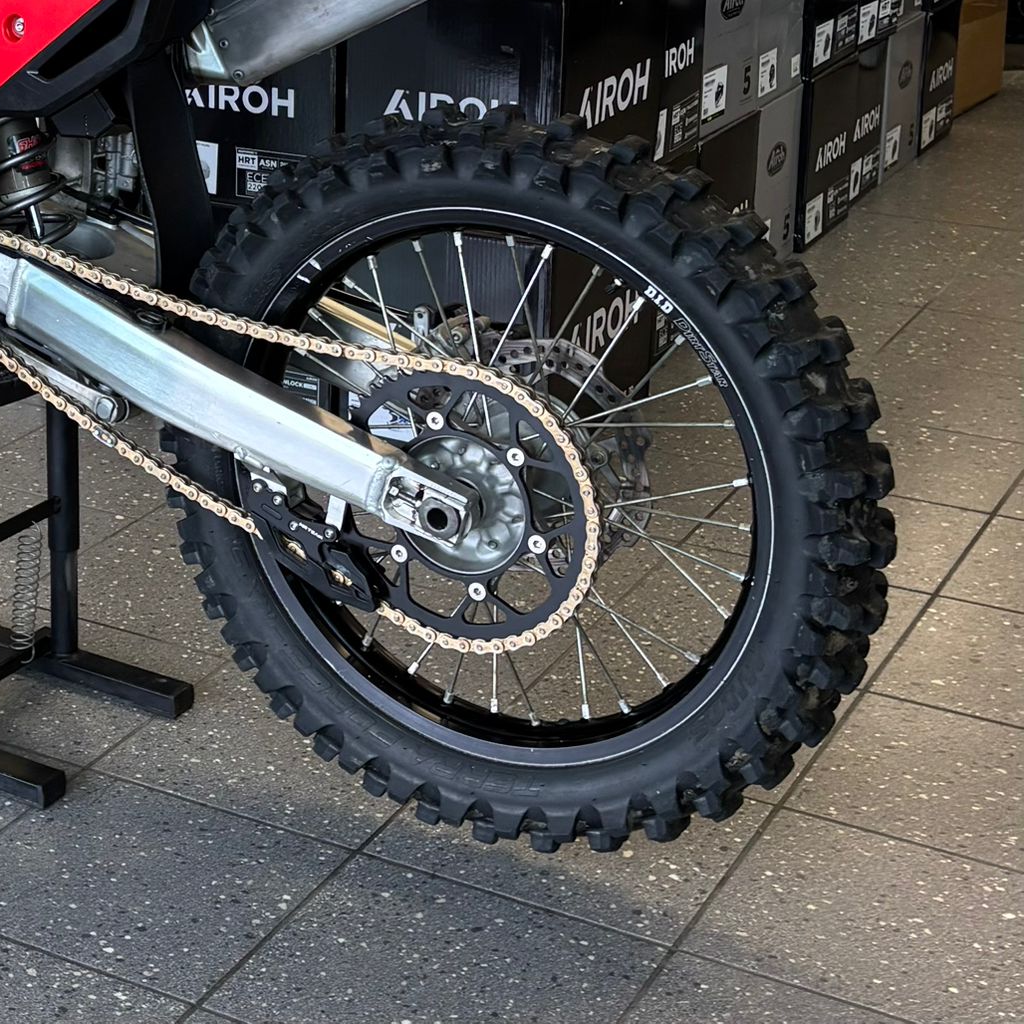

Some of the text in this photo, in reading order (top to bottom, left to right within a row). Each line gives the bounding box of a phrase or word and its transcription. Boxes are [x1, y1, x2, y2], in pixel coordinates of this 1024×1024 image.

[743, 67, 751, 96] 5
[929, 57, 953, 92] AIROH
[184, 84, 295, 119] AIROH
[382, 88, 518, 123] AIRO
[579, 58, 651, 130] AIROH
[853, 104, 881, 143] AIROH
[238, 156, 277, 168] HRT ASN
[815, 132, 847, 173] AIROH
[782, 213, 791, 241] 5
